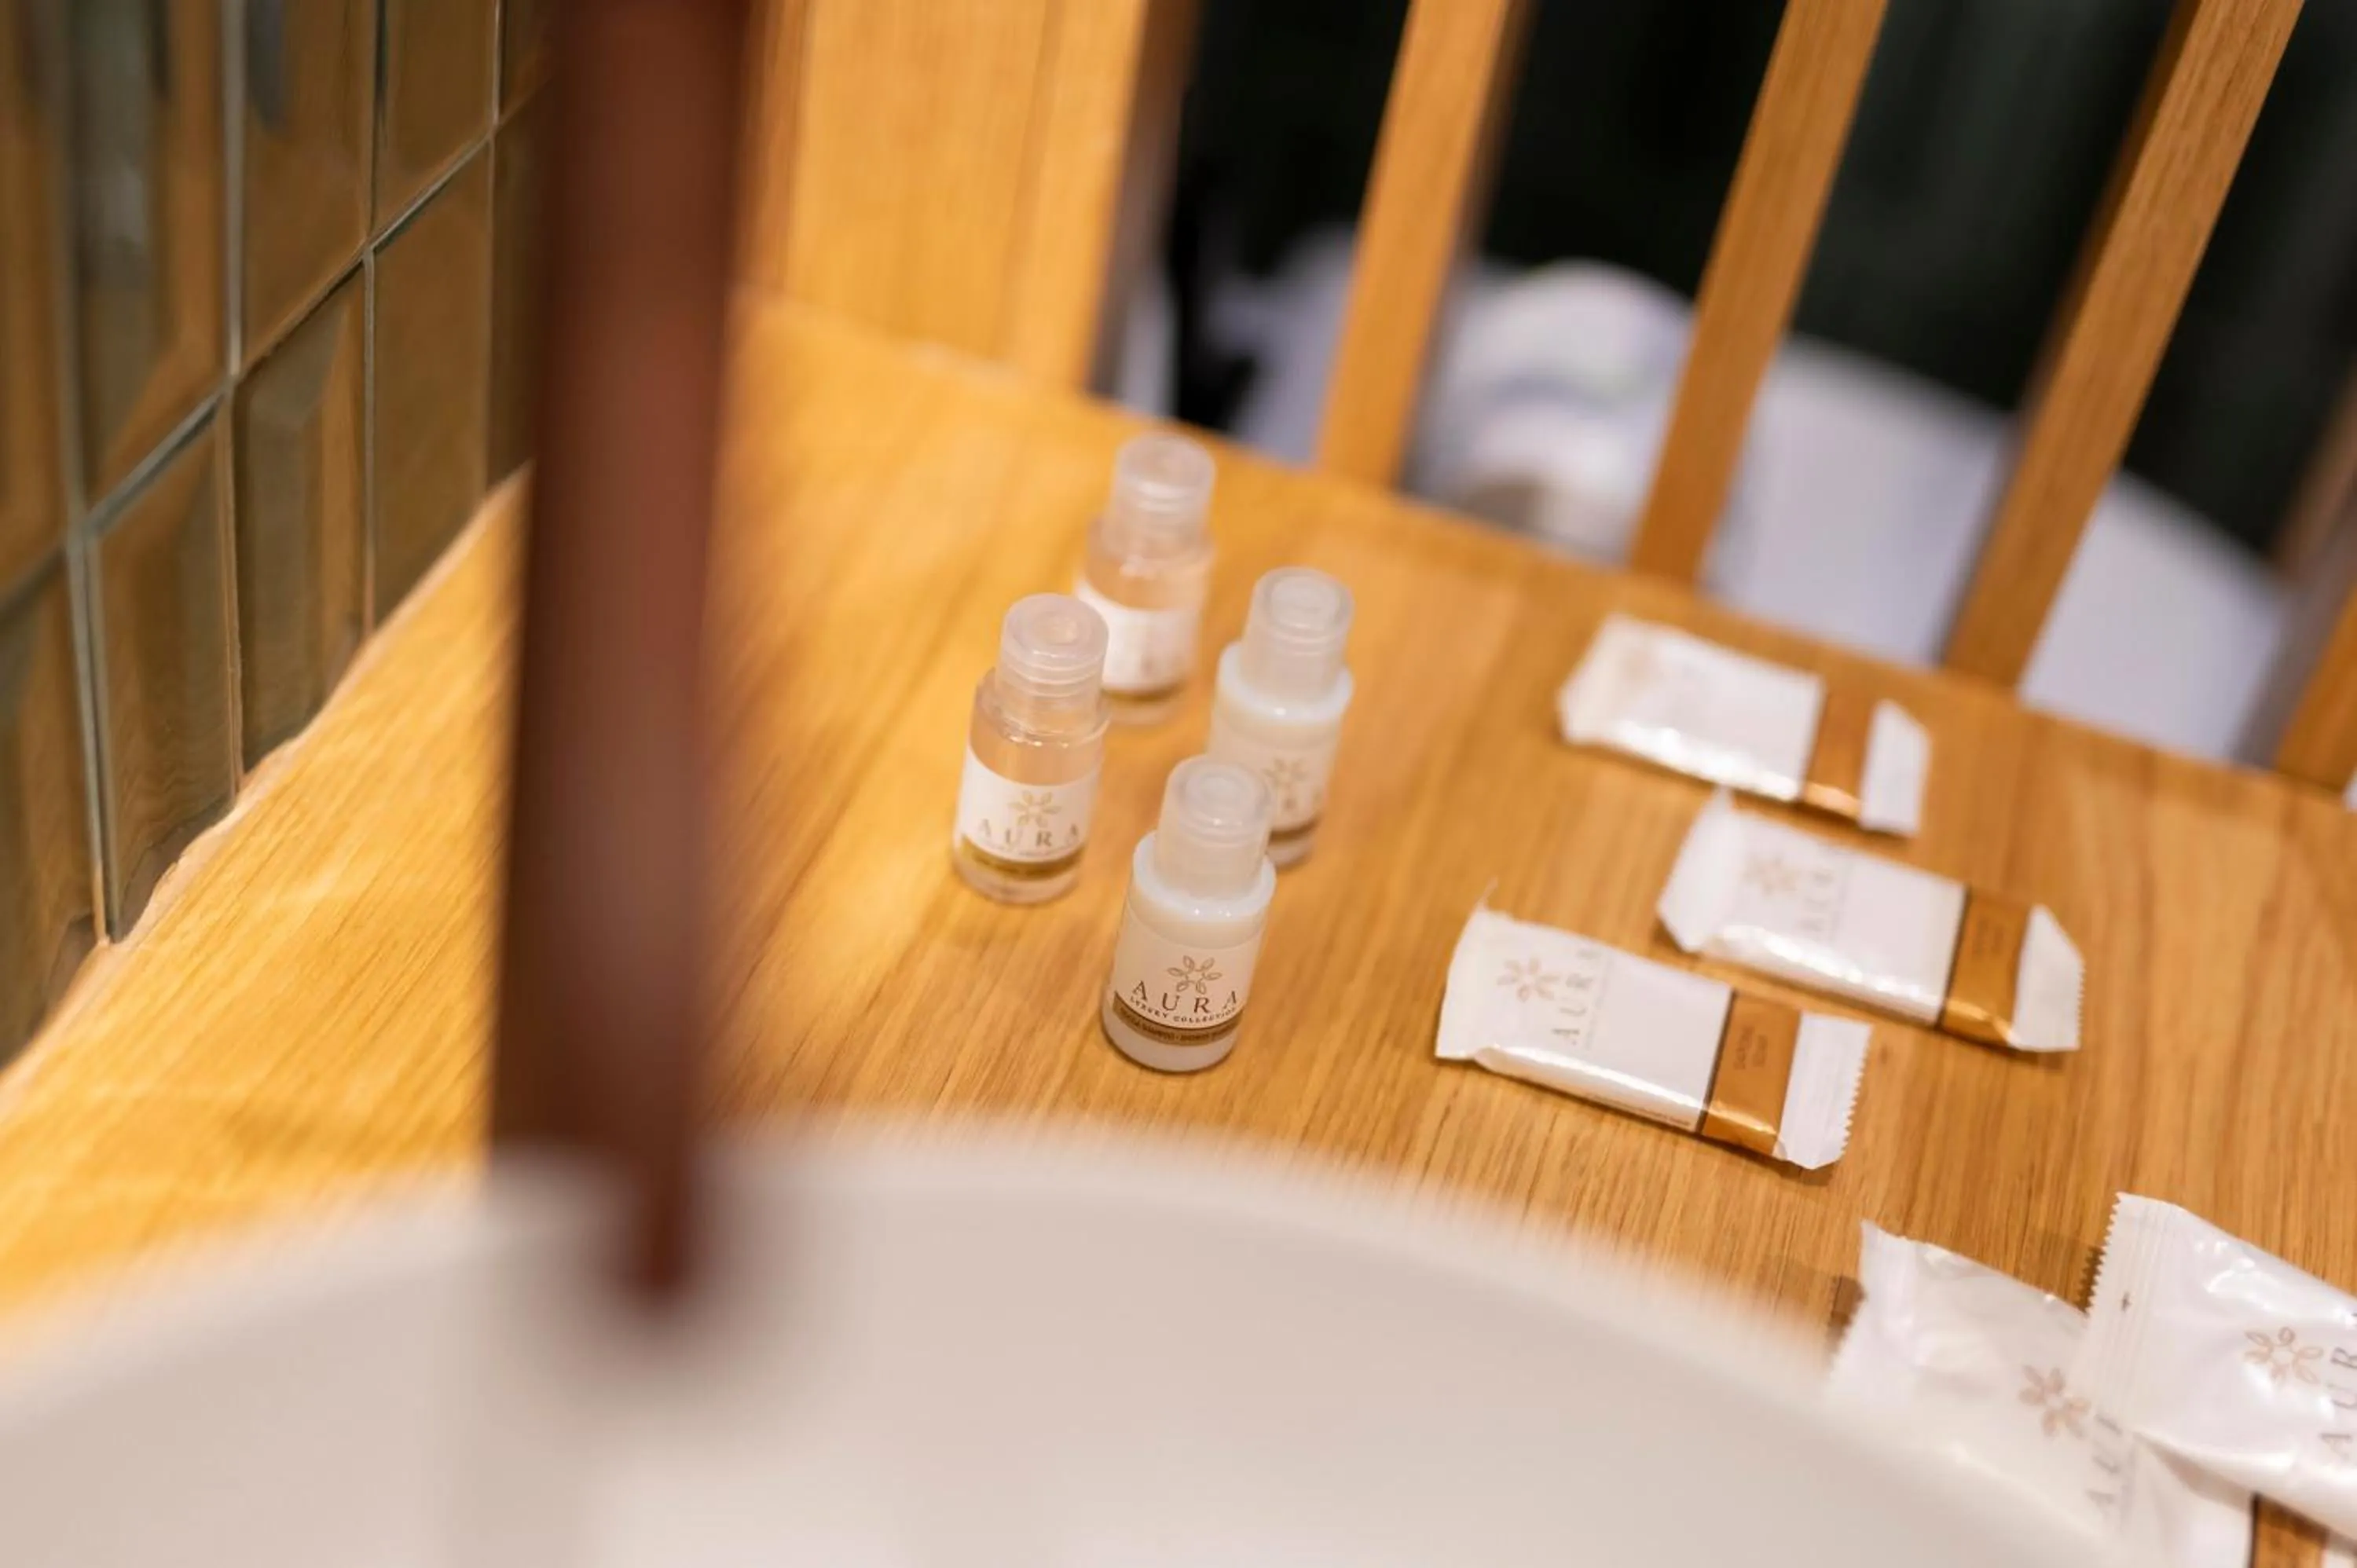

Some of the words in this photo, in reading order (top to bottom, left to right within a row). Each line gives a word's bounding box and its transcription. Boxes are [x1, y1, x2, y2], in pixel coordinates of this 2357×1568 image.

[977, 818, 1080, 848] AURA
[1131, 980, 1237, 1014] AURA
[2319, 1310, 2357, 1461] AUR
